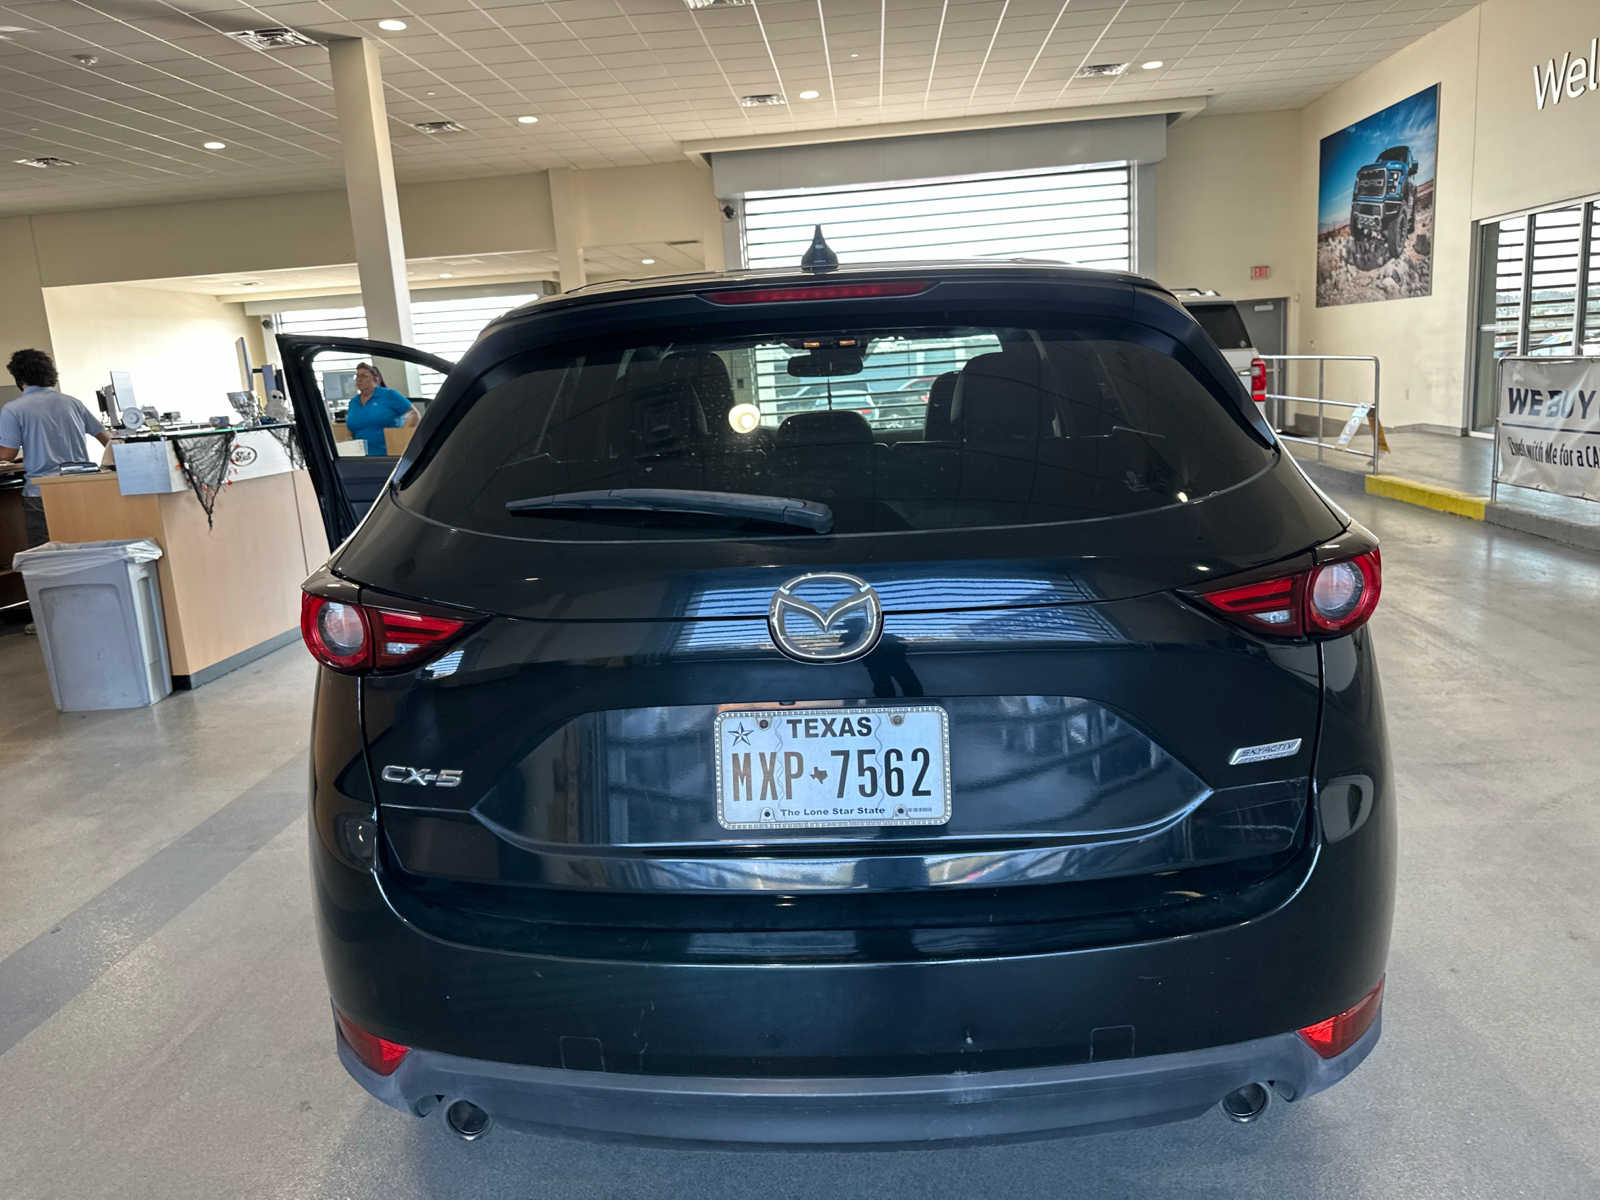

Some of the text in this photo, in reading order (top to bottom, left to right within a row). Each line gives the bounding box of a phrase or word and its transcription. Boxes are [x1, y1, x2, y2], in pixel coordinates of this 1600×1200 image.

[1533, 37, 1600, 110] Wel
[1508, 387, 1597, 420] WE BUY
[1560, 443, 1574, 467] for
[1577, 450, 1584, 467] a
[1586, 445, 1600, 469] CA
[786, 717, 873, 739] TEXAS
[381, 765, 463, 788] CX-5
[731, 747, 932, 801] MXP 7562
[780, 807, 886, 817] The Lone Star State
